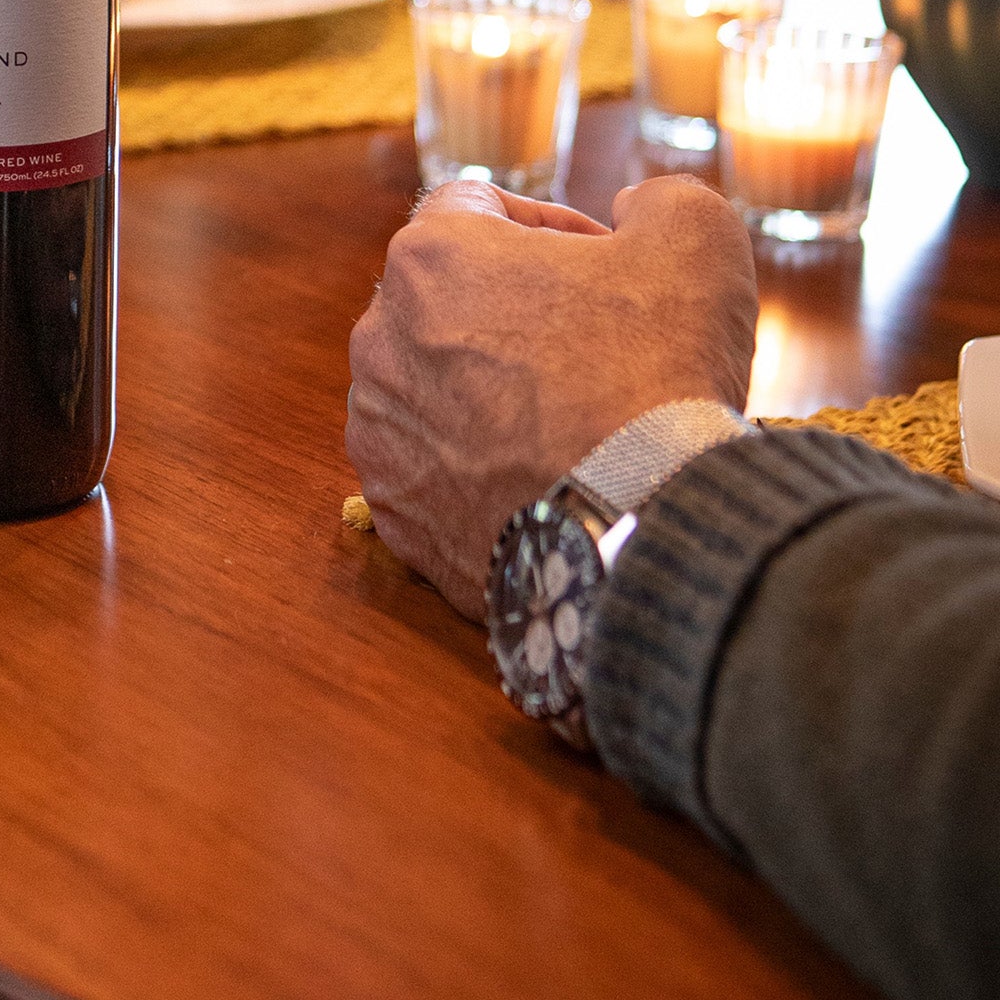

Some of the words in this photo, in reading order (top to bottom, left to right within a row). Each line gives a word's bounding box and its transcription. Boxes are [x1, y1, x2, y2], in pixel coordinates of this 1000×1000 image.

[28, 152, 63, 166] WINE
[33, 167, 58, 180] (24.5
[59, 166, 70, 176] FL
